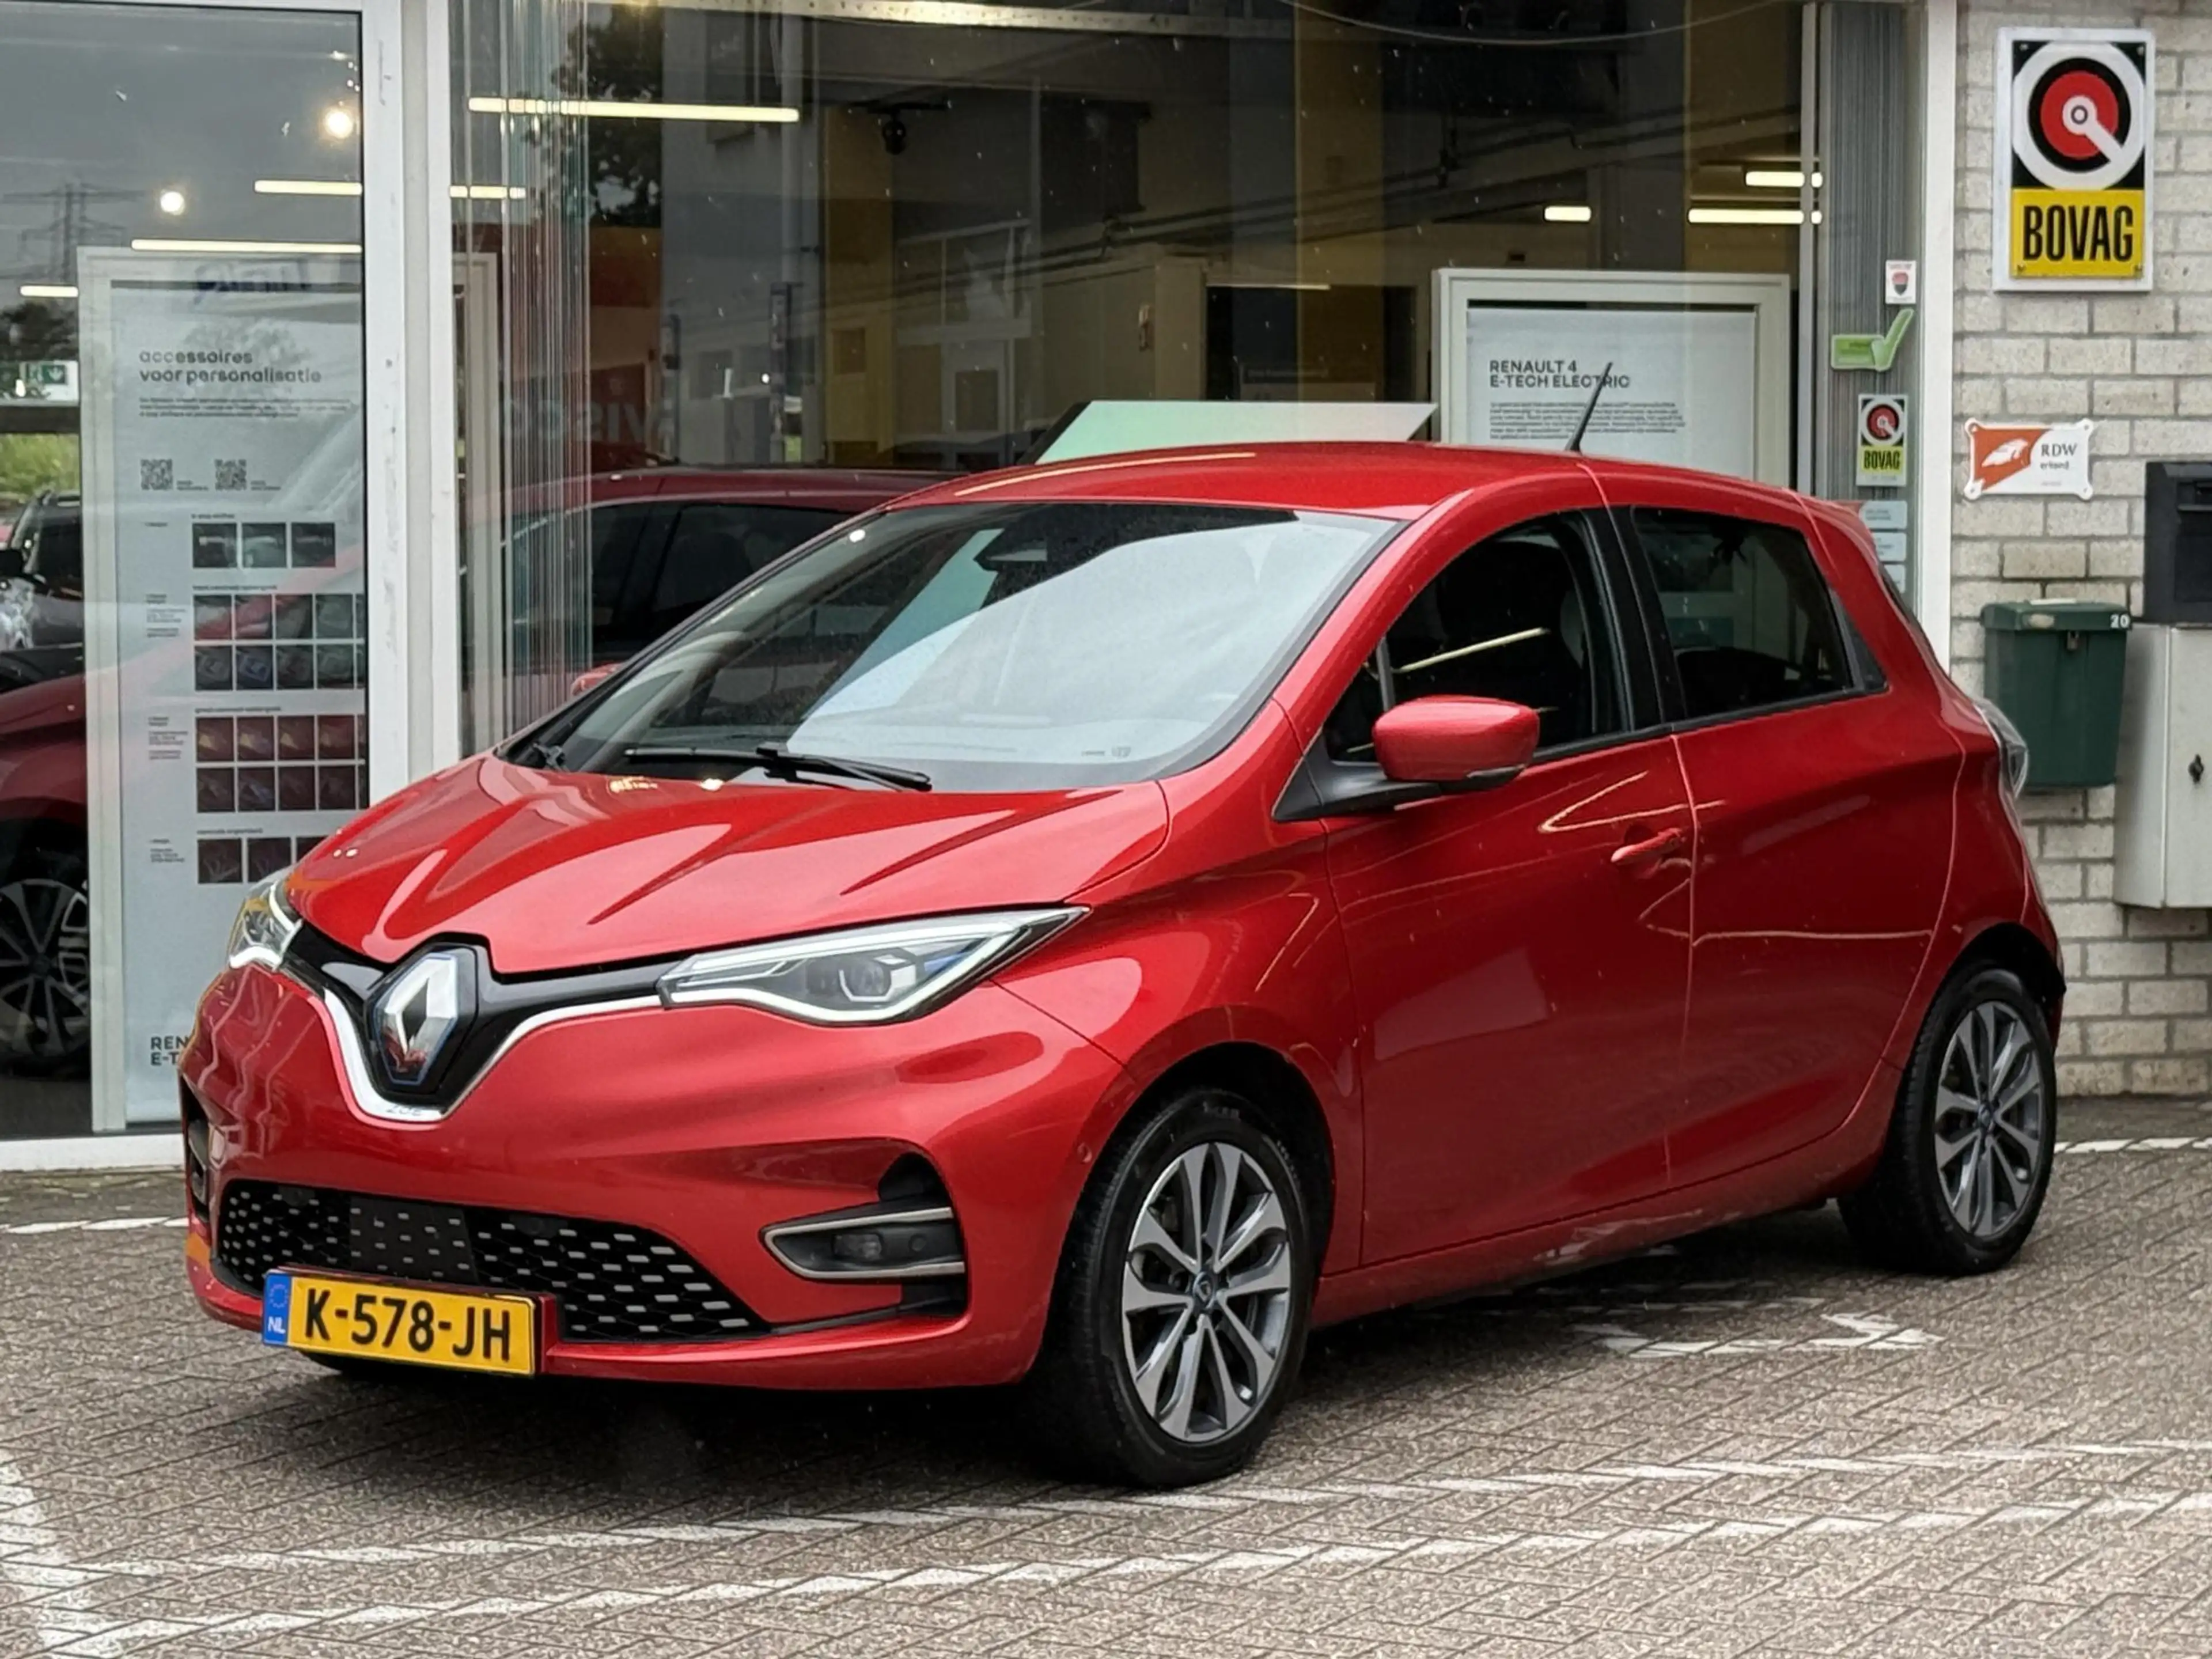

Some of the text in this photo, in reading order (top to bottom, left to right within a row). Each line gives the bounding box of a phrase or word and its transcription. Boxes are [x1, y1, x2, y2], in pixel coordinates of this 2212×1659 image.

[2023, 205, 2133, 262] BOVAG
[139, 350, 252, 363] accessoires
[1490, 360, 1577, 373] RENAULT 4
[139, 368, 321, 385] voor personalisatie
[1490, 375, 1549, 388] E-TECH
[2041, 443, 2077, 457] RDW
[1863, 450, 1900, 470] BOVAG
[2110, 614, 2130, 628] 20
[268, 1316, 286, 1335] NL
[305, 1288, 510, 1361] K-578-JH
